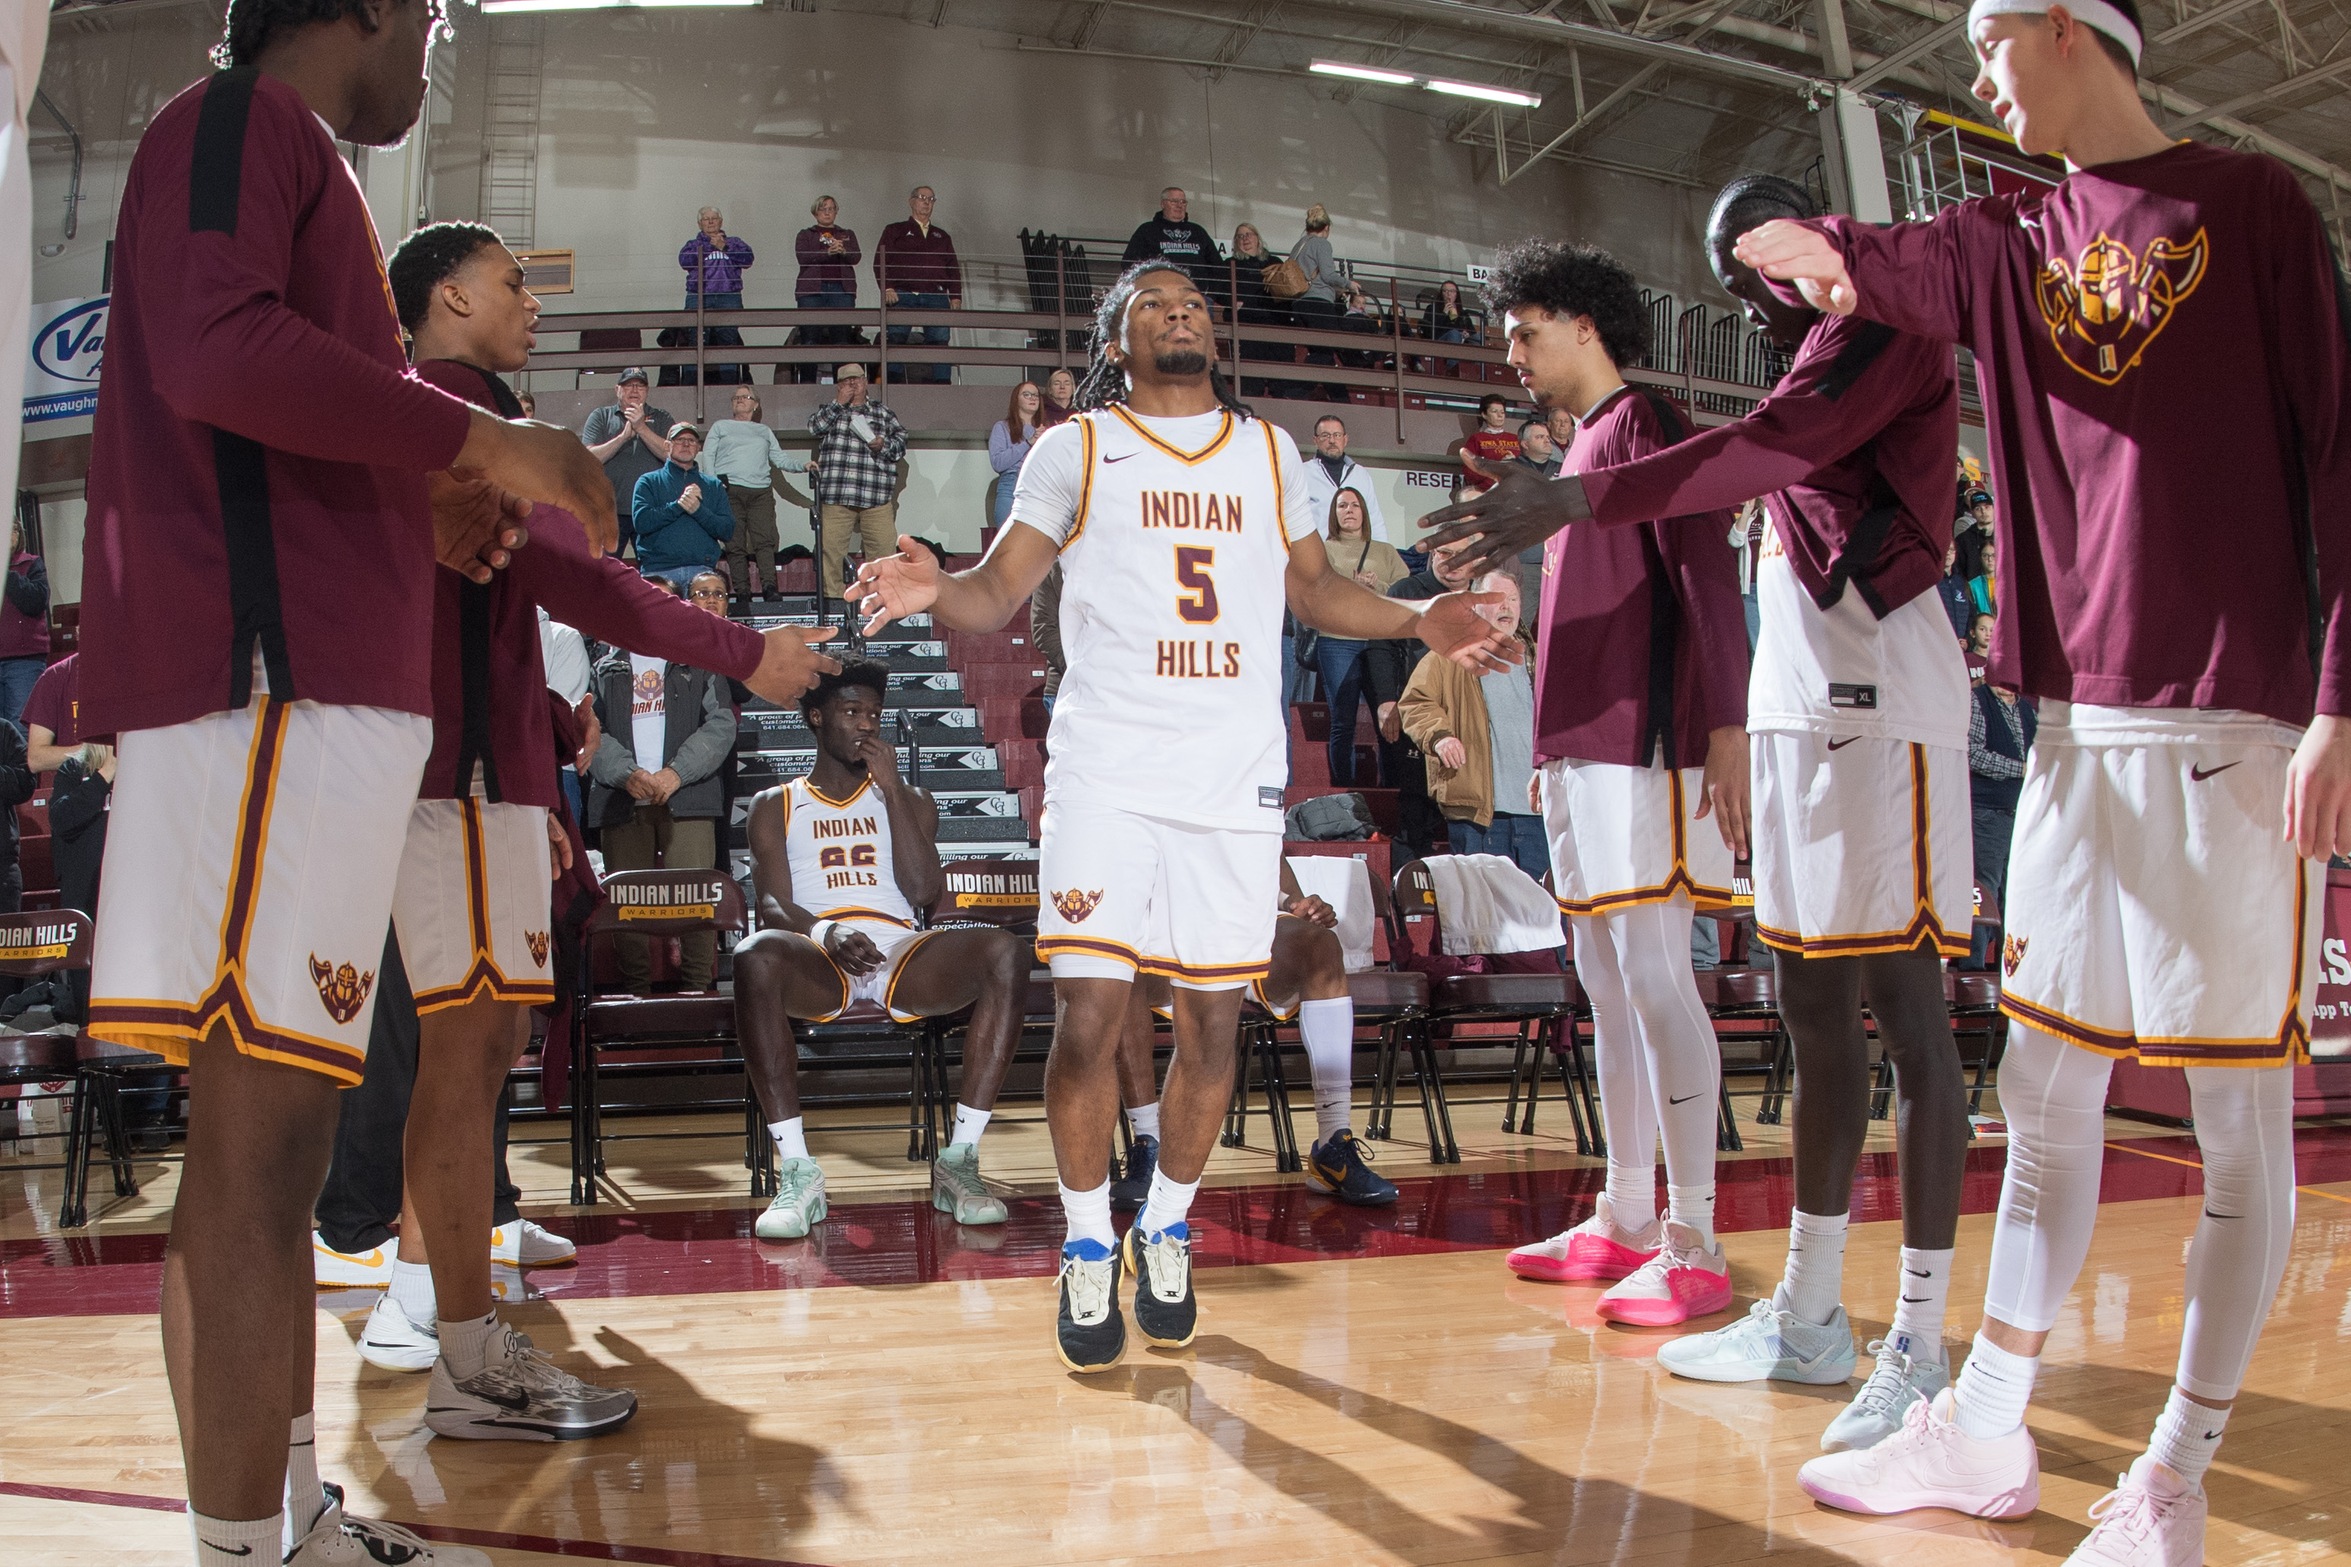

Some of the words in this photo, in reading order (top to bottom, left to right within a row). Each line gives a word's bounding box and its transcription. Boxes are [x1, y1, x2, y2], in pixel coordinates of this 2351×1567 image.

[1473, 268, 1488, 279] BA
[22, 397, 99, 417] www.vaughn
[1406, 471, 1465, 489] RESER
[1140, 490, 1242, 534] INDIAN
[1173, 544, 1221, 625] 5
[1156, 640, 1240, 678] HILLS
[1858, 692, 1871, 702] XL
[813, 816, 878, 839] INDIAN
[826, 871, 878, 889] HILLS
[946, 873, 1005, 893] INDIAN
[1733, 878, 1753, 895] HIL
[610, 884, 669, 905] INDIAN
[674, 882, 723, 905] HILLS
[627, 907, 707, 916] WARRIORS
[0, 927, 32, 947] DIAN
[35, 922, 78, 946] HILLS
